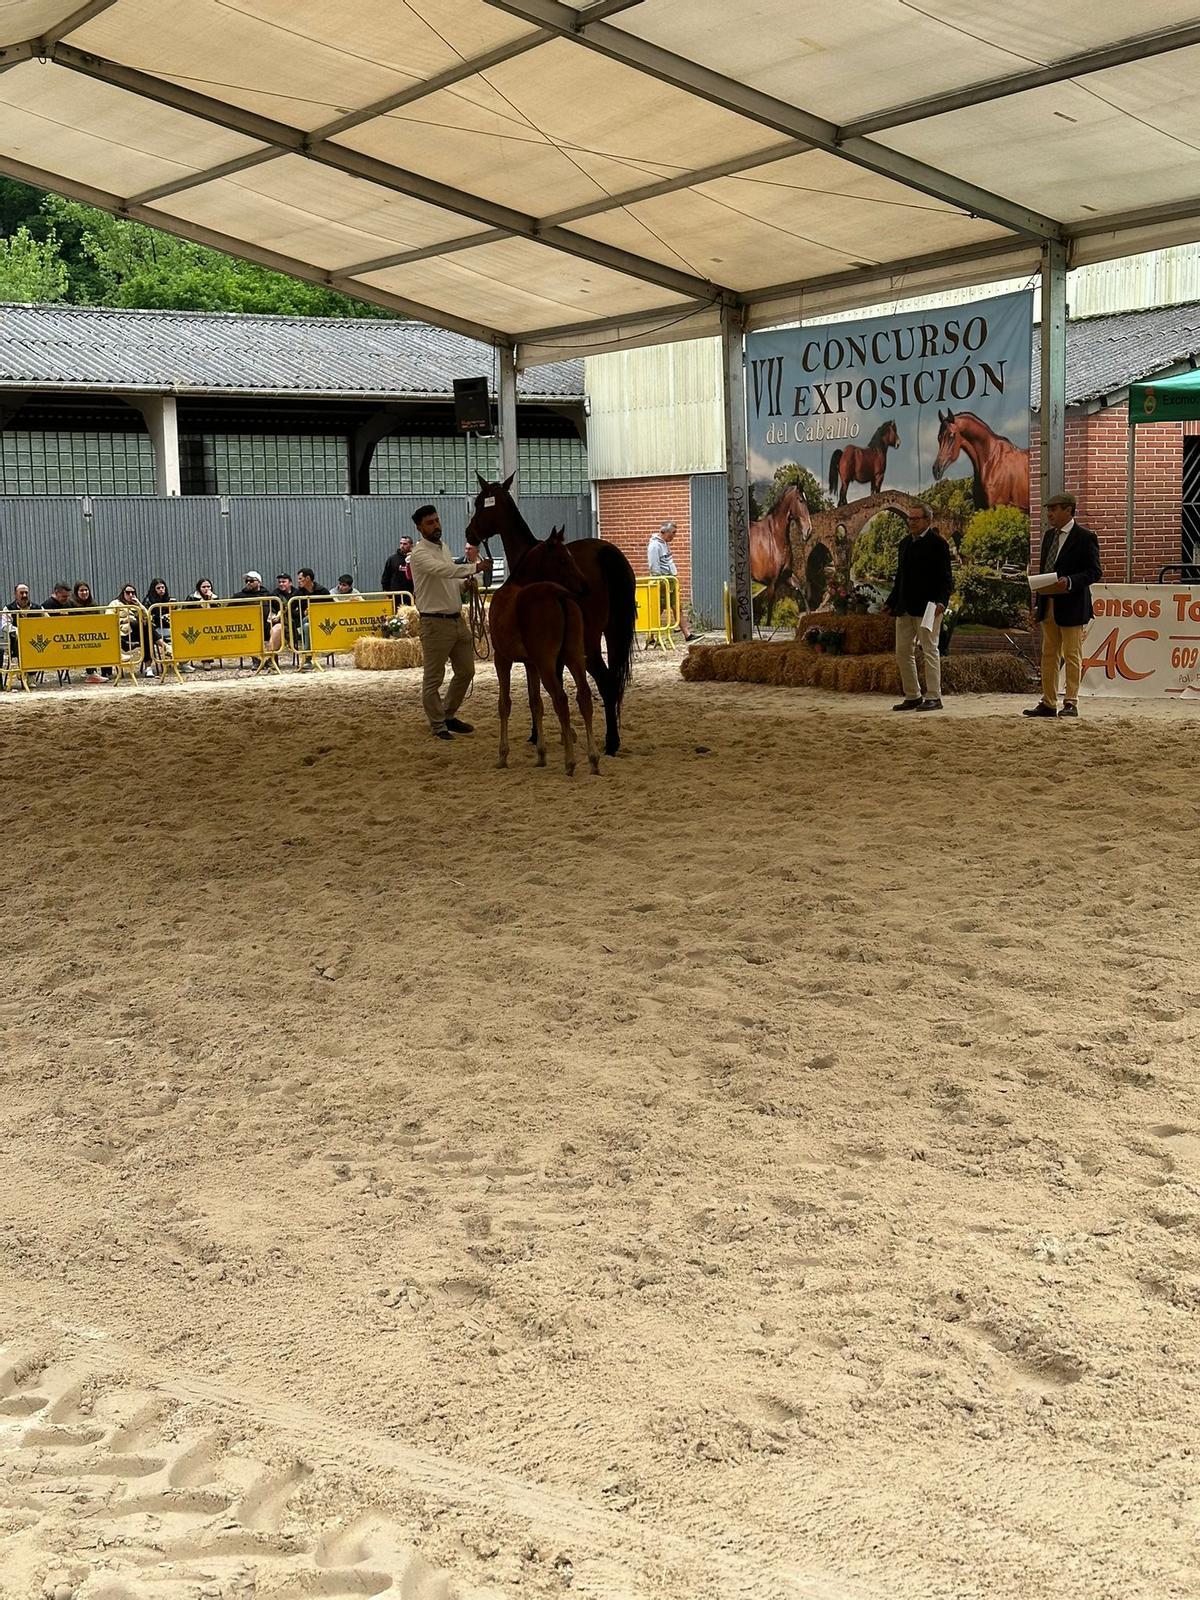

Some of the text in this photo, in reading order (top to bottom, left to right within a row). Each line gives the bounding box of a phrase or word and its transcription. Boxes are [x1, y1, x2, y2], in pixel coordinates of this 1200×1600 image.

[802, 316, 988, 373] CONCURSO
[751, 356, 785, 420] VII
[791, 354, 1008, 417] EXPOSICIÓN
[766, 416, 860, 445] del Caballo
[1092, 598, 1161, 618] ensos
[203, 623, 255, 634] CAJA RURAL
[339, 617, 358, 626] CAJA
[53, 632, 110, 643] CAJA RURAL
[1080, 627, 1159, 682] AC
[1171, 647, 1199, 669] 609
